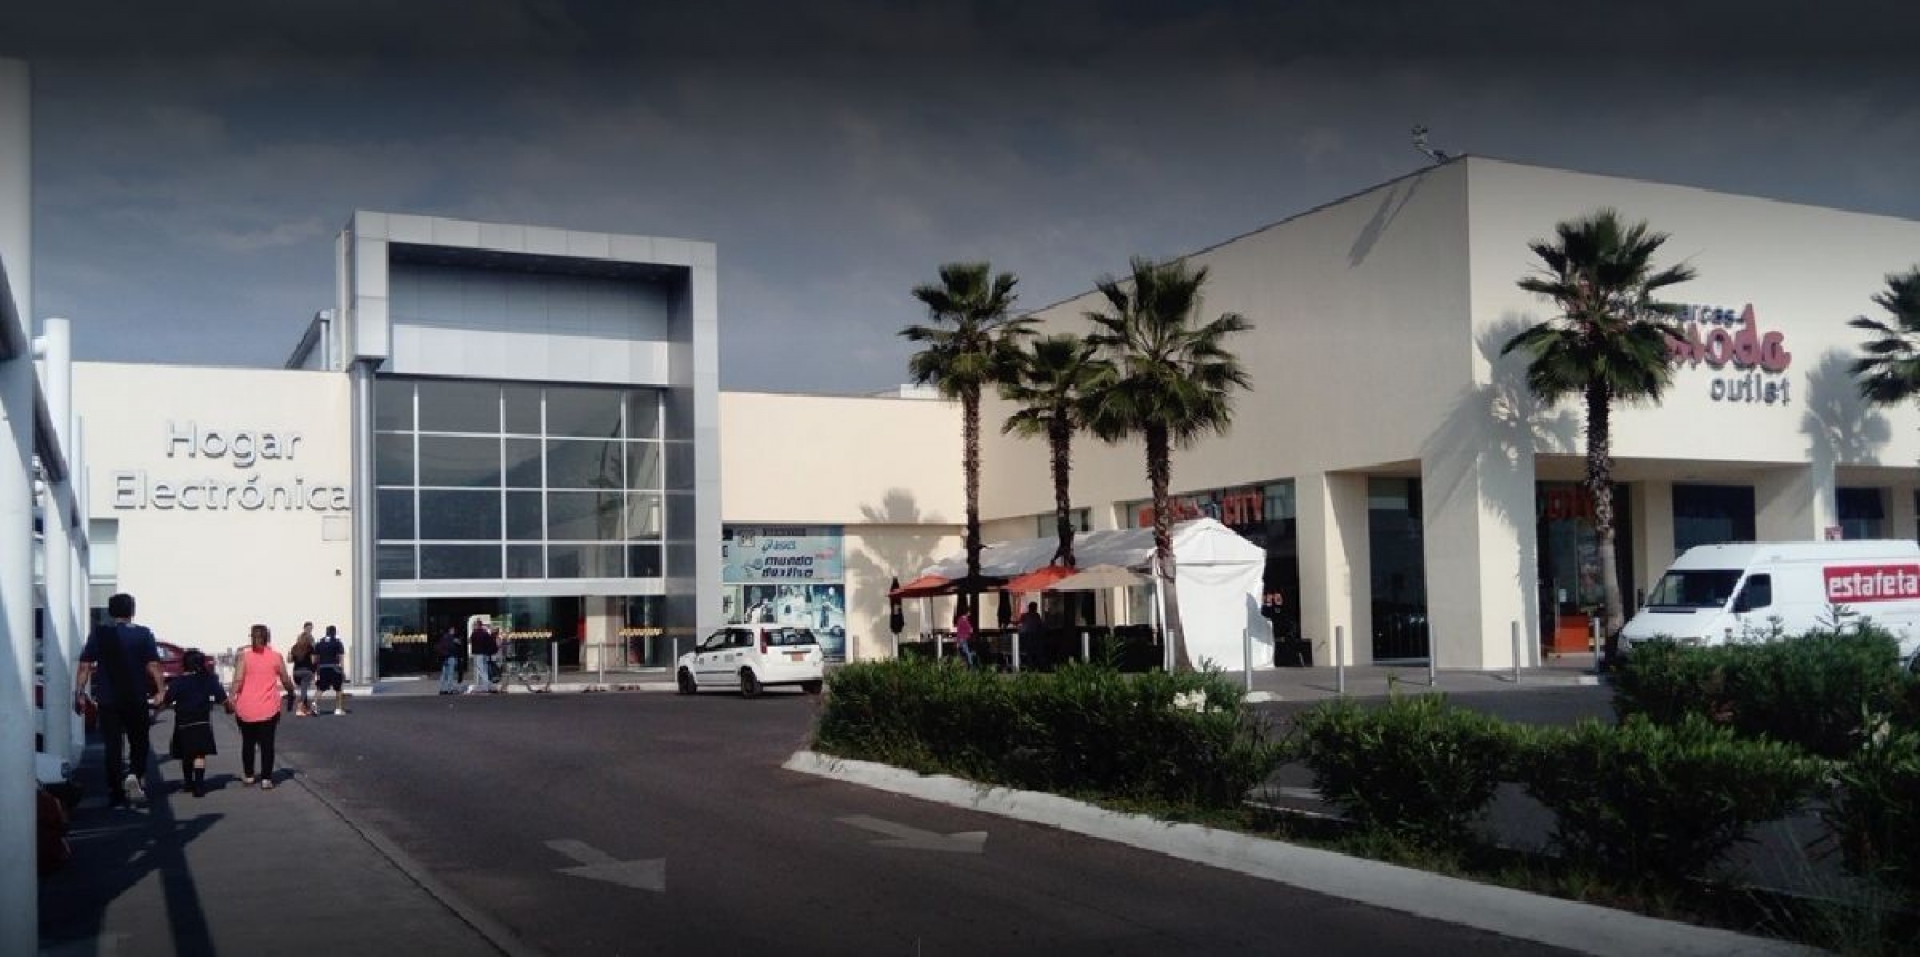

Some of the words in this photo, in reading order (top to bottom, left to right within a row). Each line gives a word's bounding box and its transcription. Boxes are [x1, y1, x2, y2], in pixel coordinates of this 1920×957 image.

[1711, 375, 1790, 405] outlet
[166, 420, 301, 468] Hogar
[113, 468, 350, 511] Electrónica
[1223, 490, 1263, 524] CITY
[1829, 570, 1917, 597] estafeta
